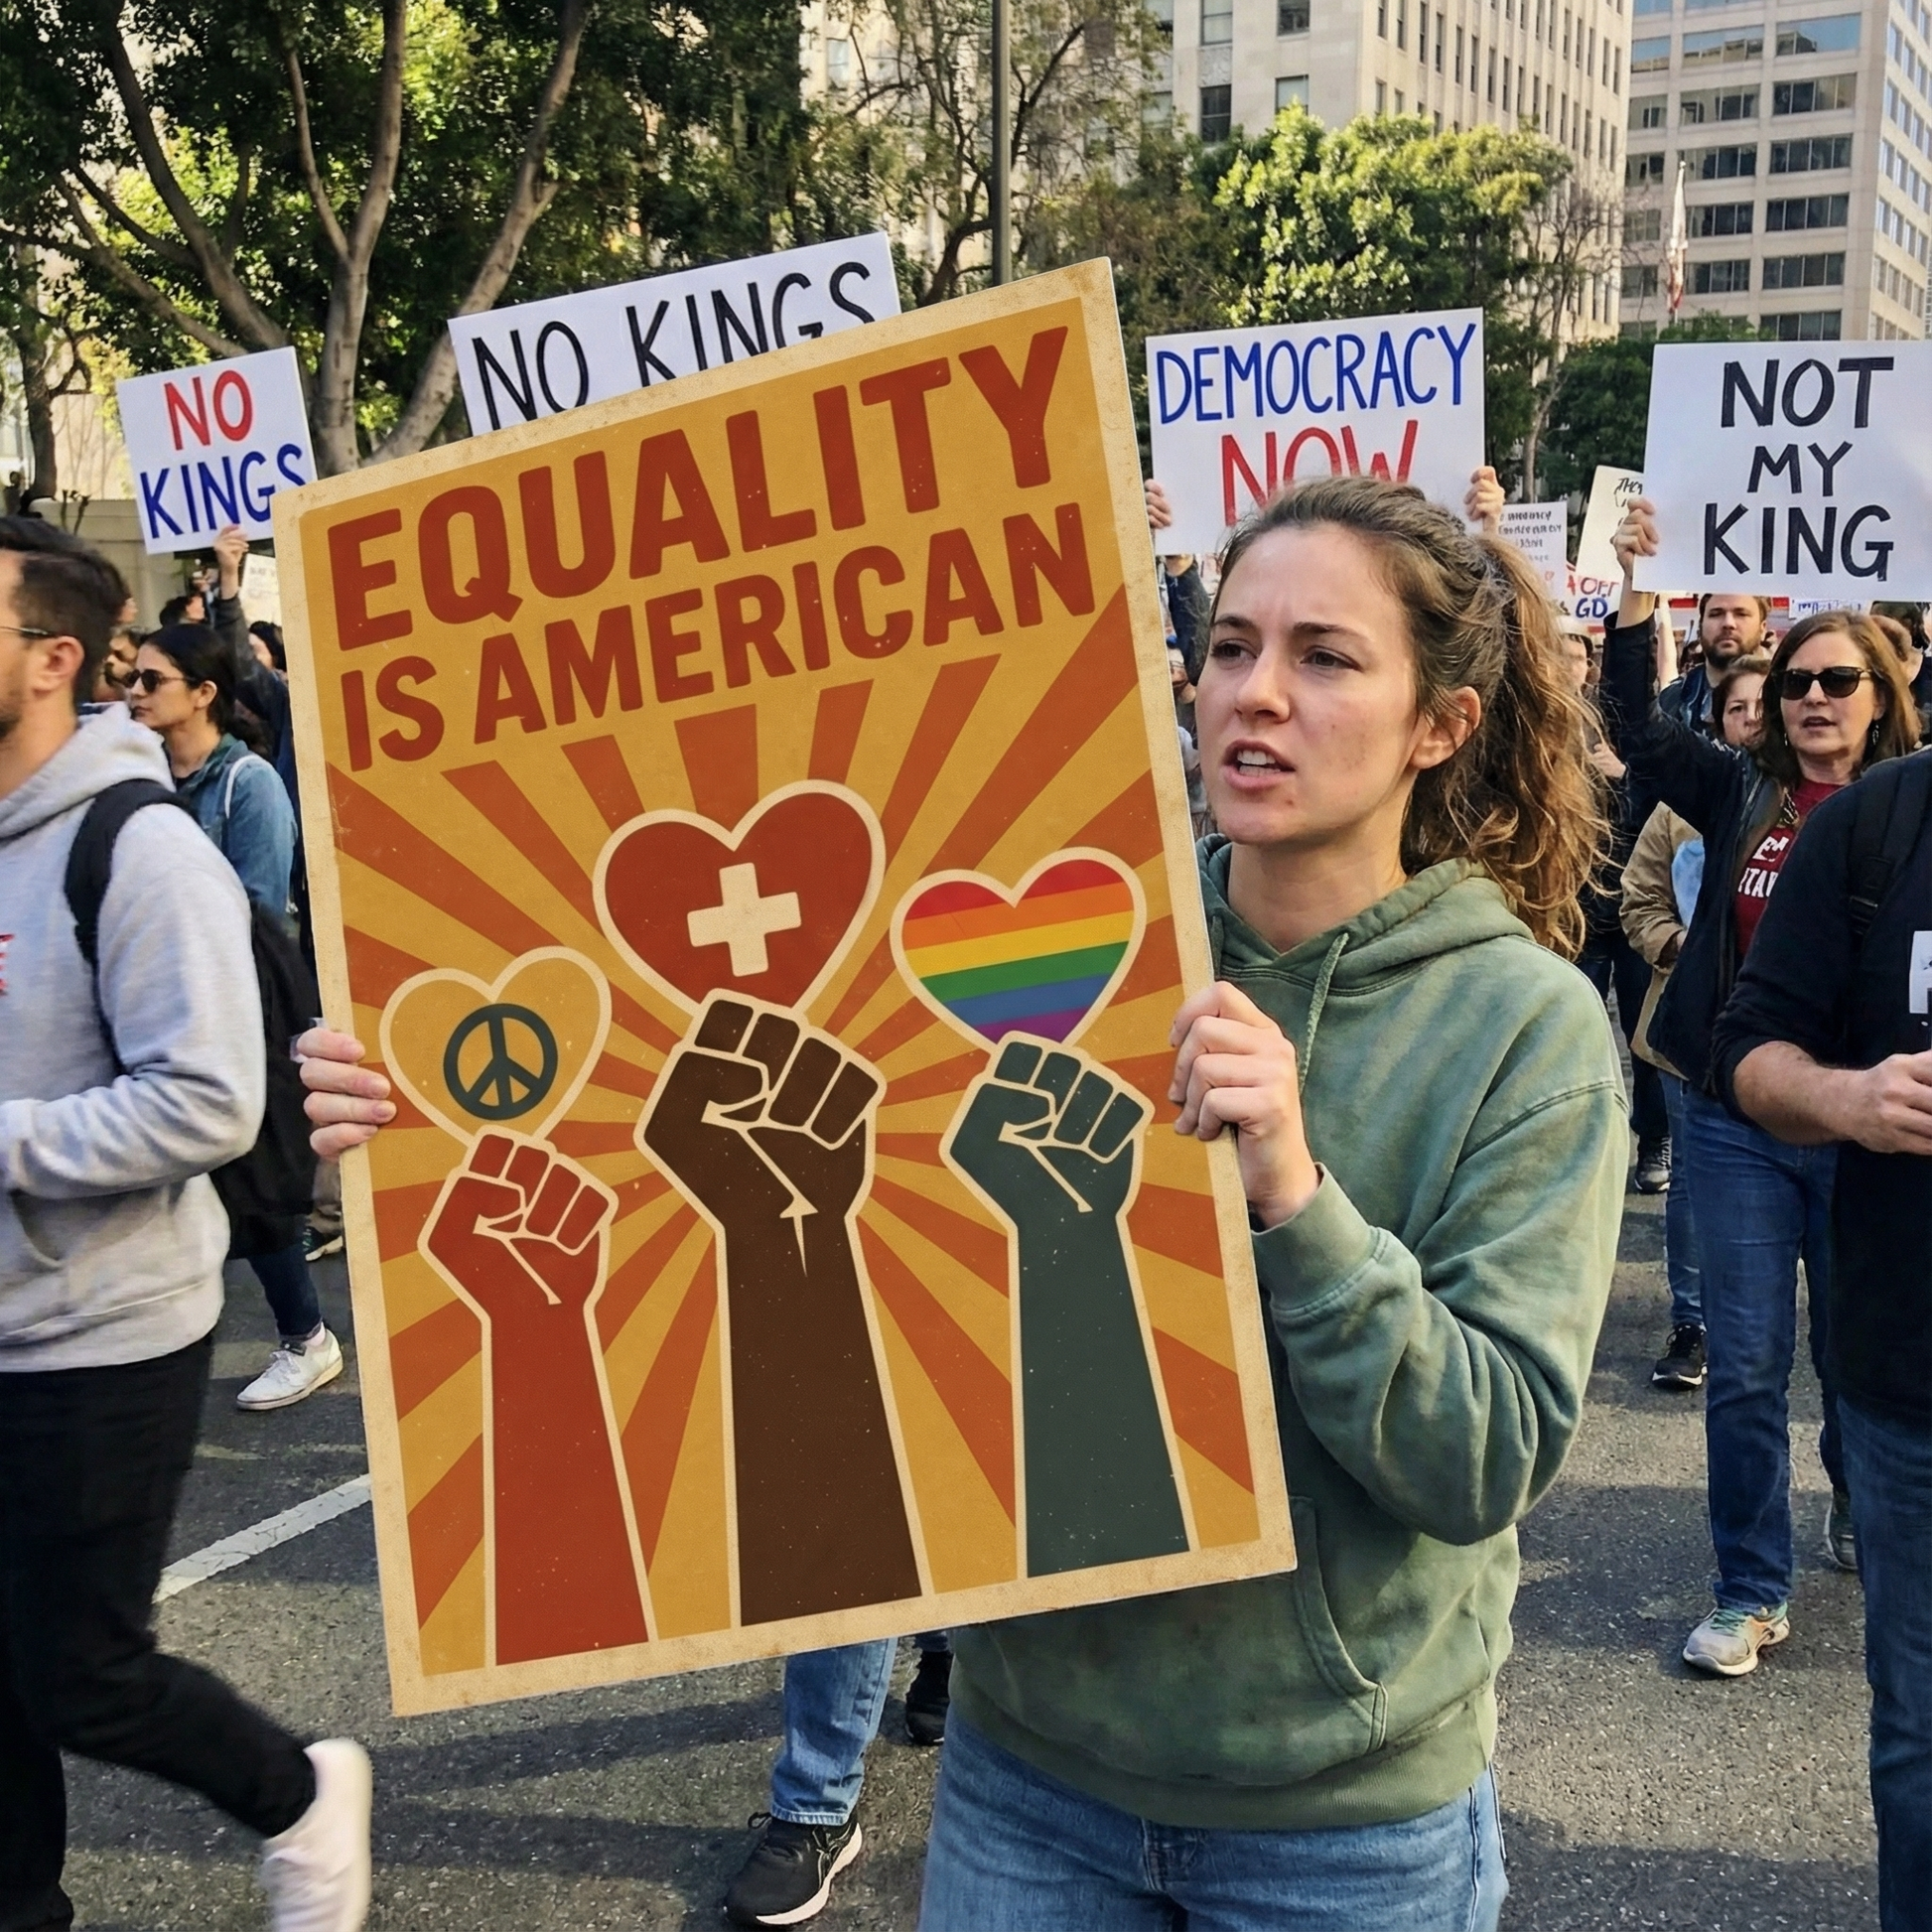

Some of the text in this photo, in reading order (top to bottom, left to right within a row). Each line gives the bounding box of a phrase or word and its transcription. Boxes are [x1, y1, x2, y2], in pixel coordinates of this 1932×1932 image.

[473, 261, 876, 430] NO KINGS
[1156, 323, 1476, 425] DEMOCRACY
[1721, 356, 1894, 429] NOT
[163, 369, 253, 451] NO
[139, 443, 307, 539] KINGS
[327, 326, 1068, 651] EQUALITY
[1221, 419, 1419, 526] NOW
[1746, 440, 1854, 496] MY
[1704, 502, 1894, 582] KING
[340, 502, 1096, 771] IS AMERICAN
